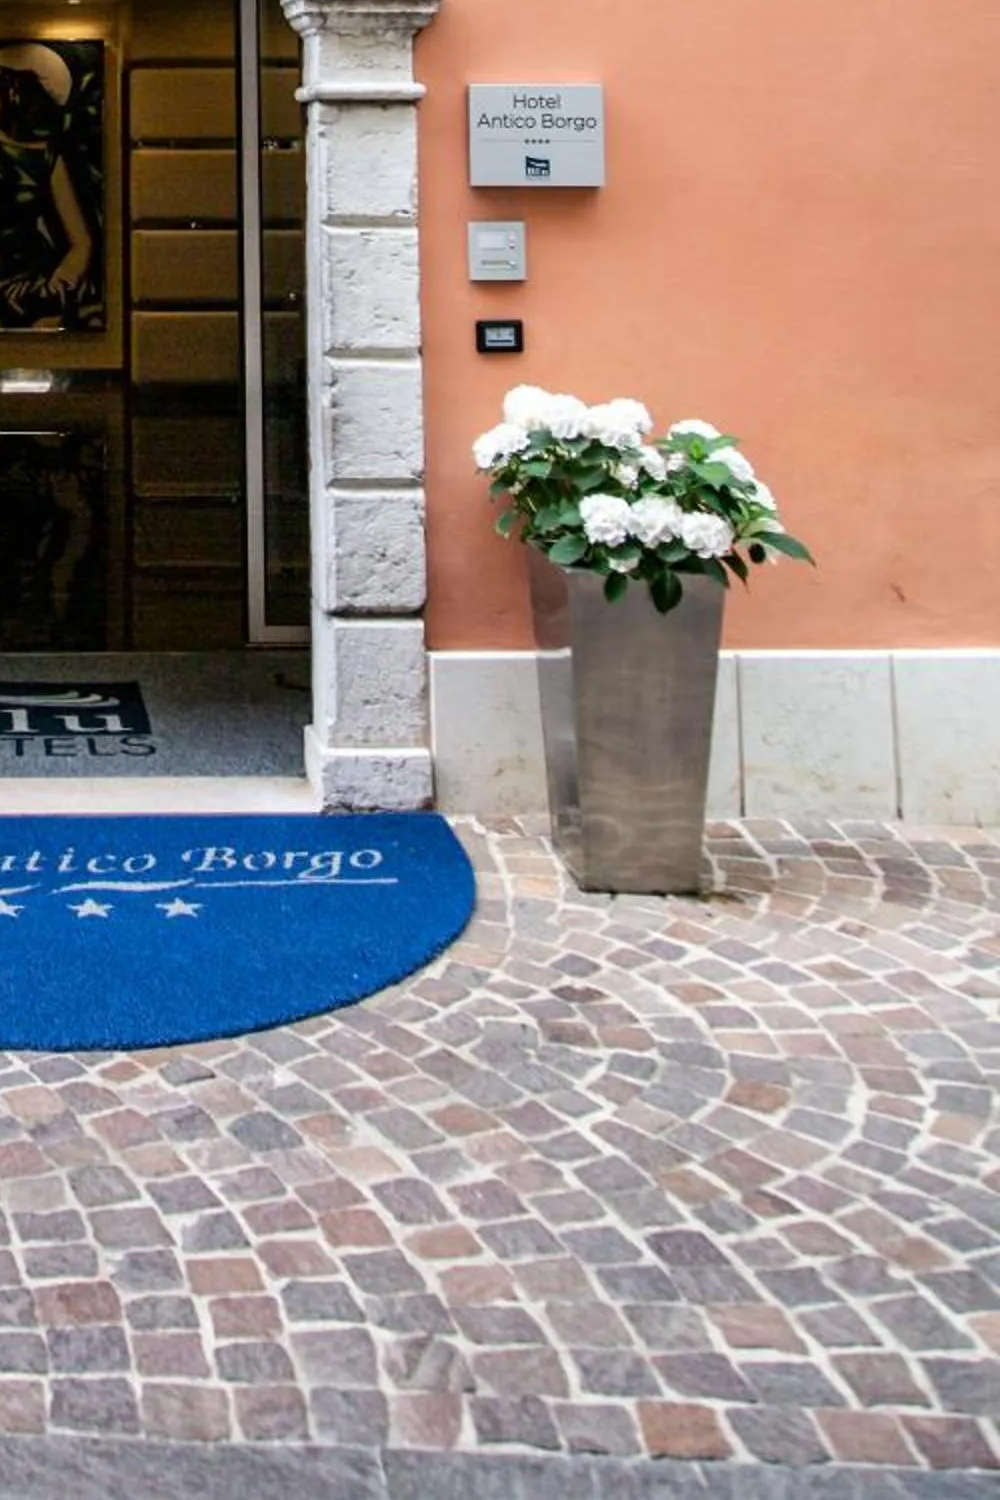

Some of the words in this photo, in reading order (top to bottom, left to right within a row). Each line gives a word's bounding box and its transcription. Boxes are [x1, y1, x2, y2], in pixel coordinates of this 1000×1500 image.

[512, 93, 562, 109] Hotel
[477, 113, 536, 129] Antico
[541, 113, 598, 132] Borgo
[181, 846, 384, 879] Borgo
